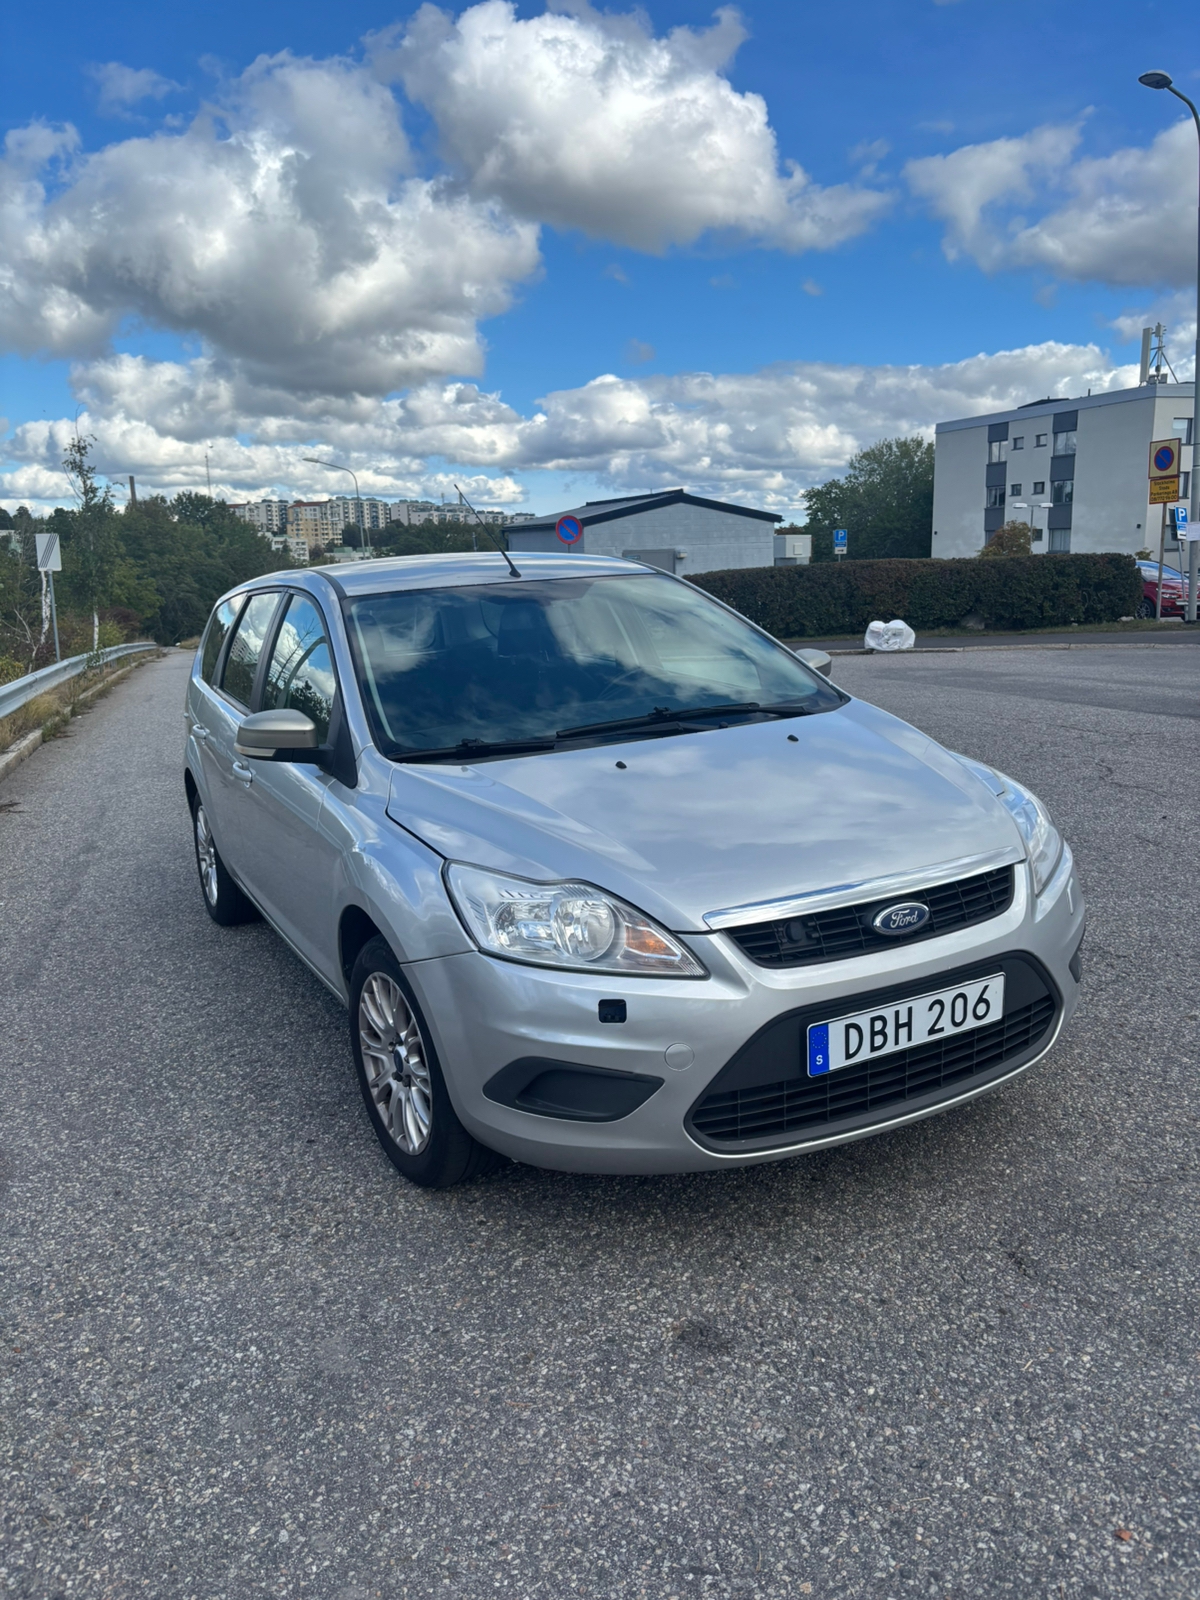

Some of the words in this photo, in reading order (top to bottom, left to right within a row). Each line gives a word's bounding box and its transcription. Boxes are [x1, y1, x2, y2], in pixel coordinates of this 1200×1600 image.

[1178, 508, 1186, 521] P
[838, 531, 845, 540] P
[890, 908, 918, 928] Ford
[844, 1006, 913, 1060] DBH
[927, 984, 990, 1036] 206
[816, 1055, 823, 1065] S
